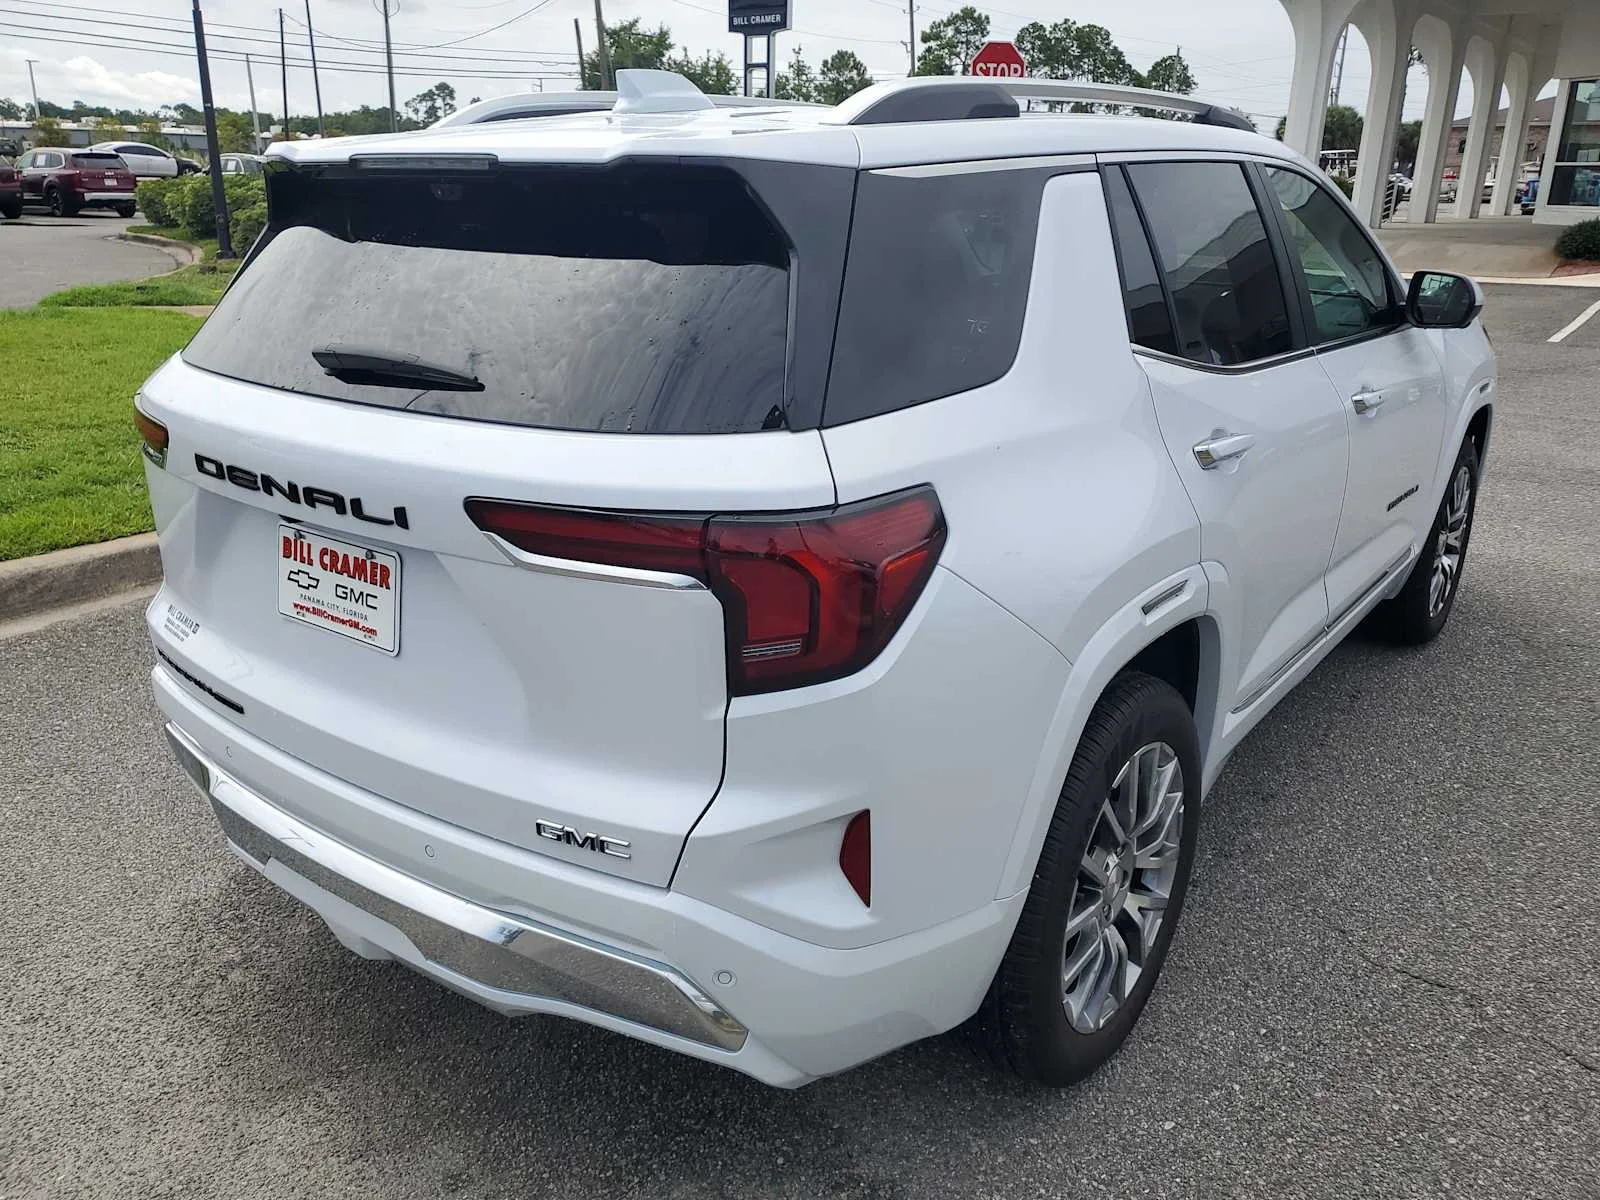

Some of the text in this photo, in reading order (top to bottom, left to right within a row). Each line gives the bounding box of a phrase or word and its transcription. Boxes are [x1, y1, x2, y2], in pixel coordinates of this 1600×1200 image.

[733, 14, 781, 25] BILL CRAMER
[976, 62, 1021, 77] STOP
[194, 453, 409, 530] DENALI
[282, 535, 391, 590] BILL CRAMER
[299, 593, 325, 607] PANAMA
[343, 607, 369, 621] FLORIDA
[335, 583, 378, 610] GMC
[292, 602, 378, 636] www.BillCramerGM.com
[536, 818, 632, 860] GMC
